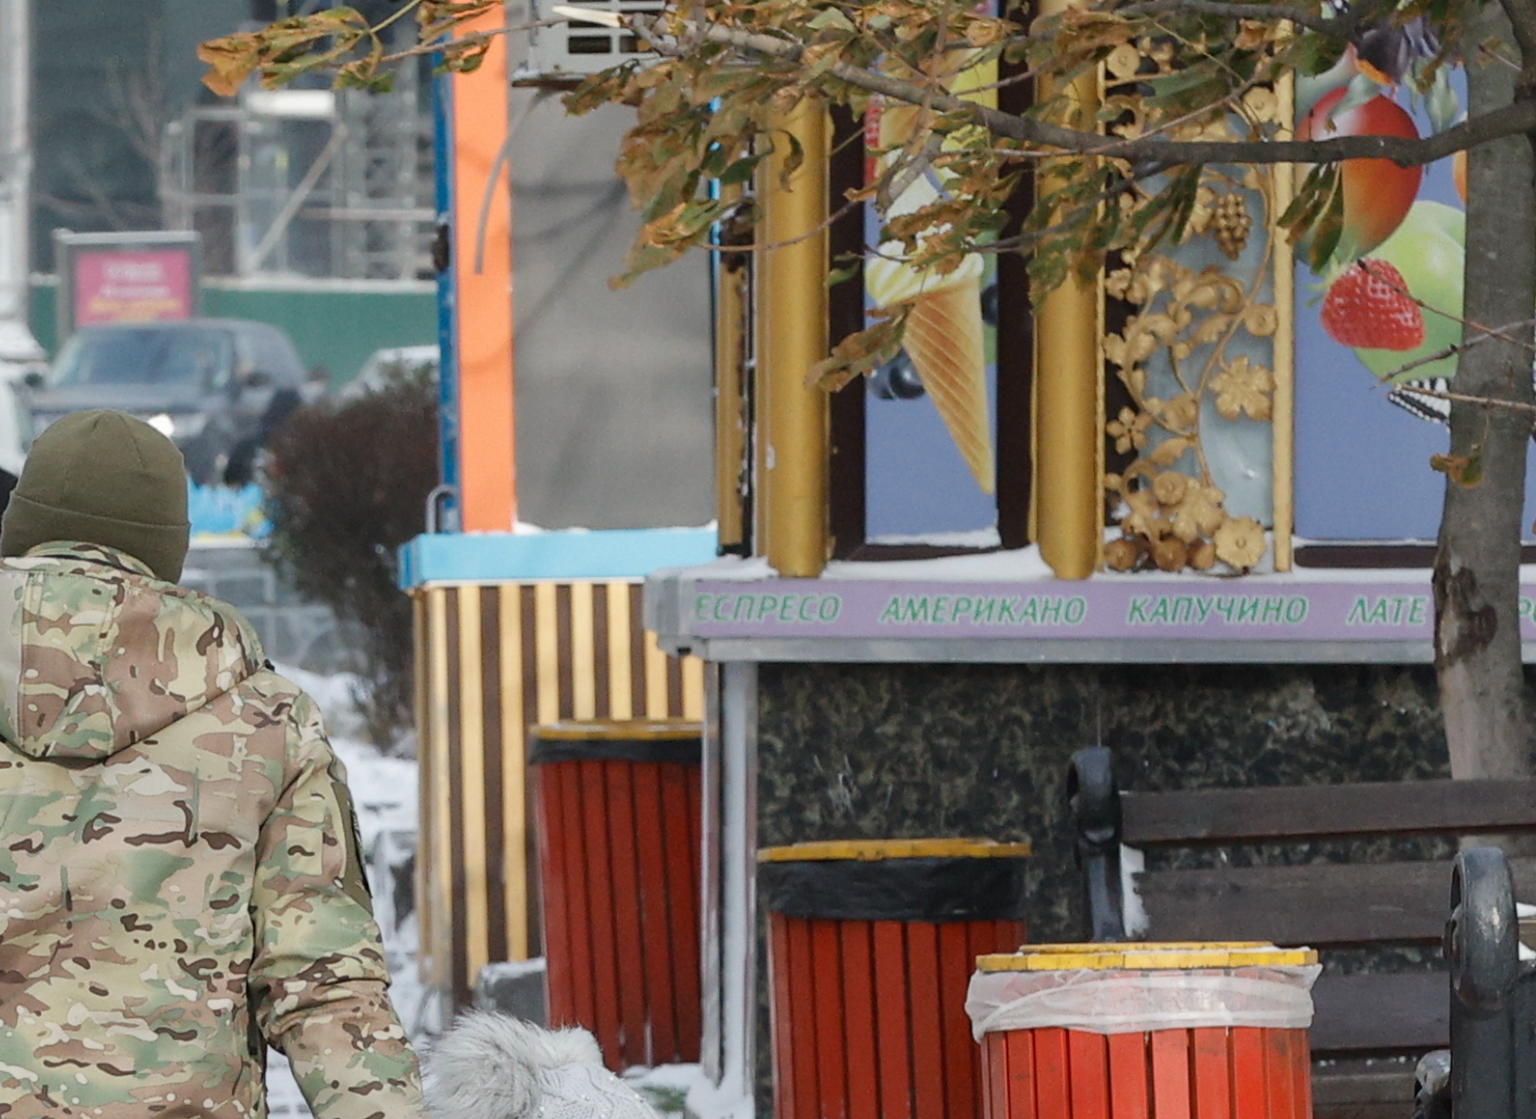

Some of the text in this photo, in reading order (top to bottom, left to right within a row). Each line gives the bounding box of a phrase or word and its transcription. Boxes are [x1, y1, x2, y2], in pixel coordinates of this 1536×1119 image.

[695, 593, 1427, 625] ЕСПРЕСО АМЕРИКАНО КАПУЧИНО ЛАТЕ
